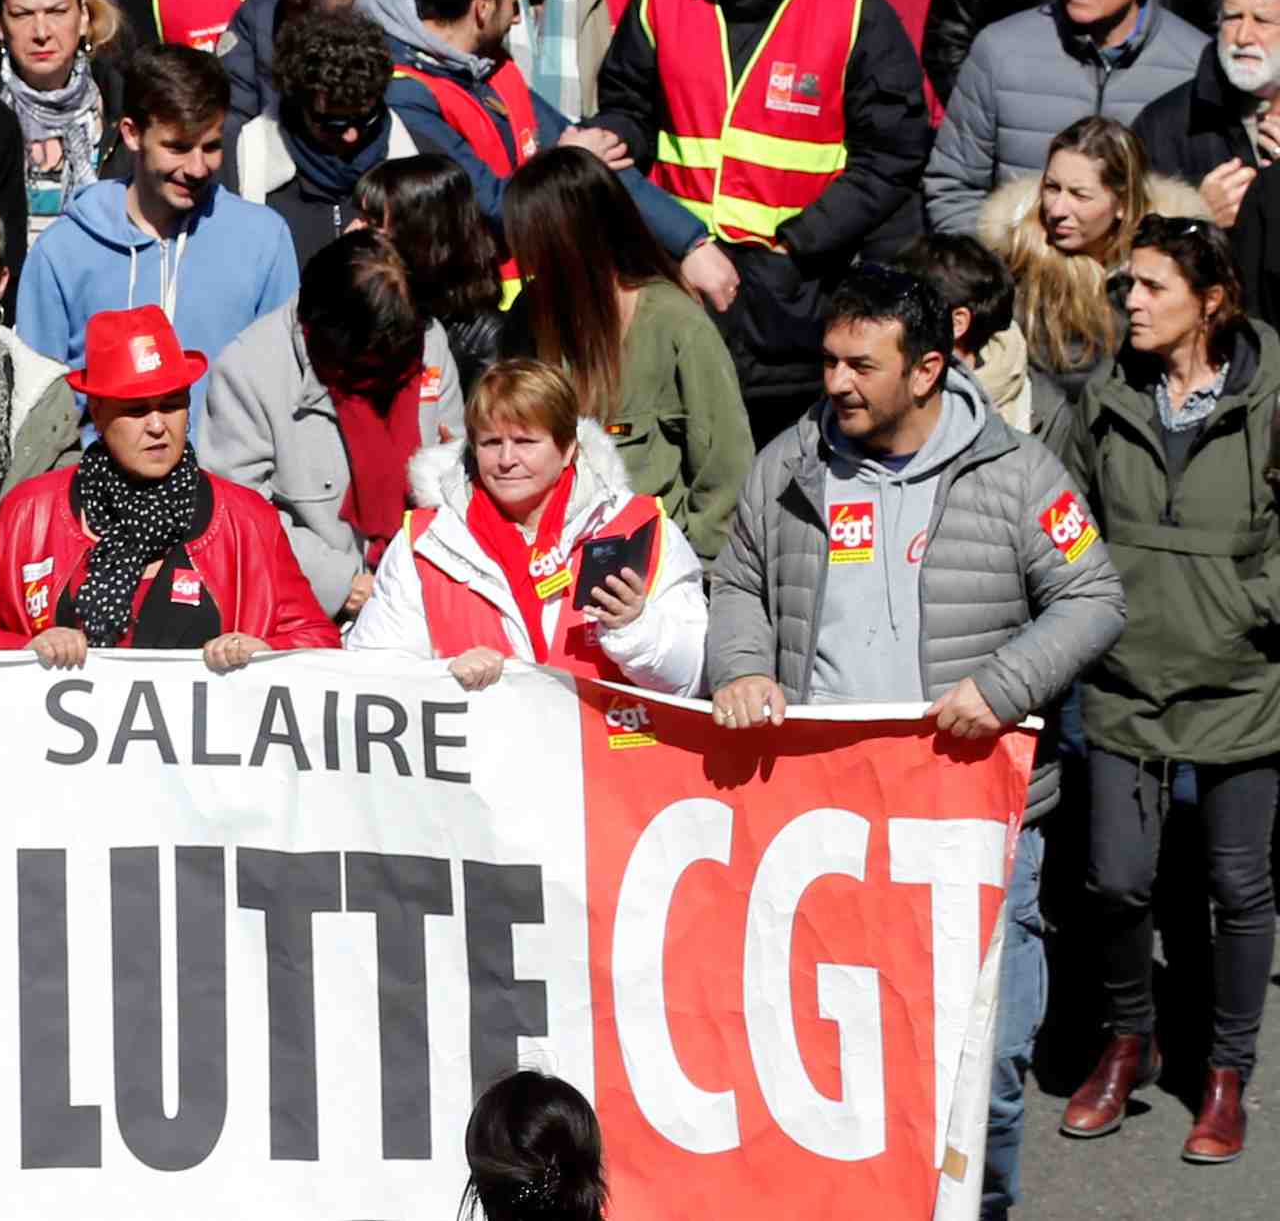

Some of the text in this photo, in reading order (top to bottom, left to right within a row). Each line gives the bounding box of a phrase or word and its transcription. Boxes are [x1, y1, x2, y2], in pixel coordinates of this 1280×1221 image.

[830, 515, 872, 547] cgt
[1051, 502, 1085, 544] cgt
[529, 546, 563, 577] cgt
[25, 583, 49, 619] cgt
[172, 580, 200, 596] cgt
[44, 679, 472, 784] SALAIRE
[606, 702, 652, 733] cgt
[16, 845, 549, 1173] LUTTE
[611, 796, 1010, 1170] CGT
